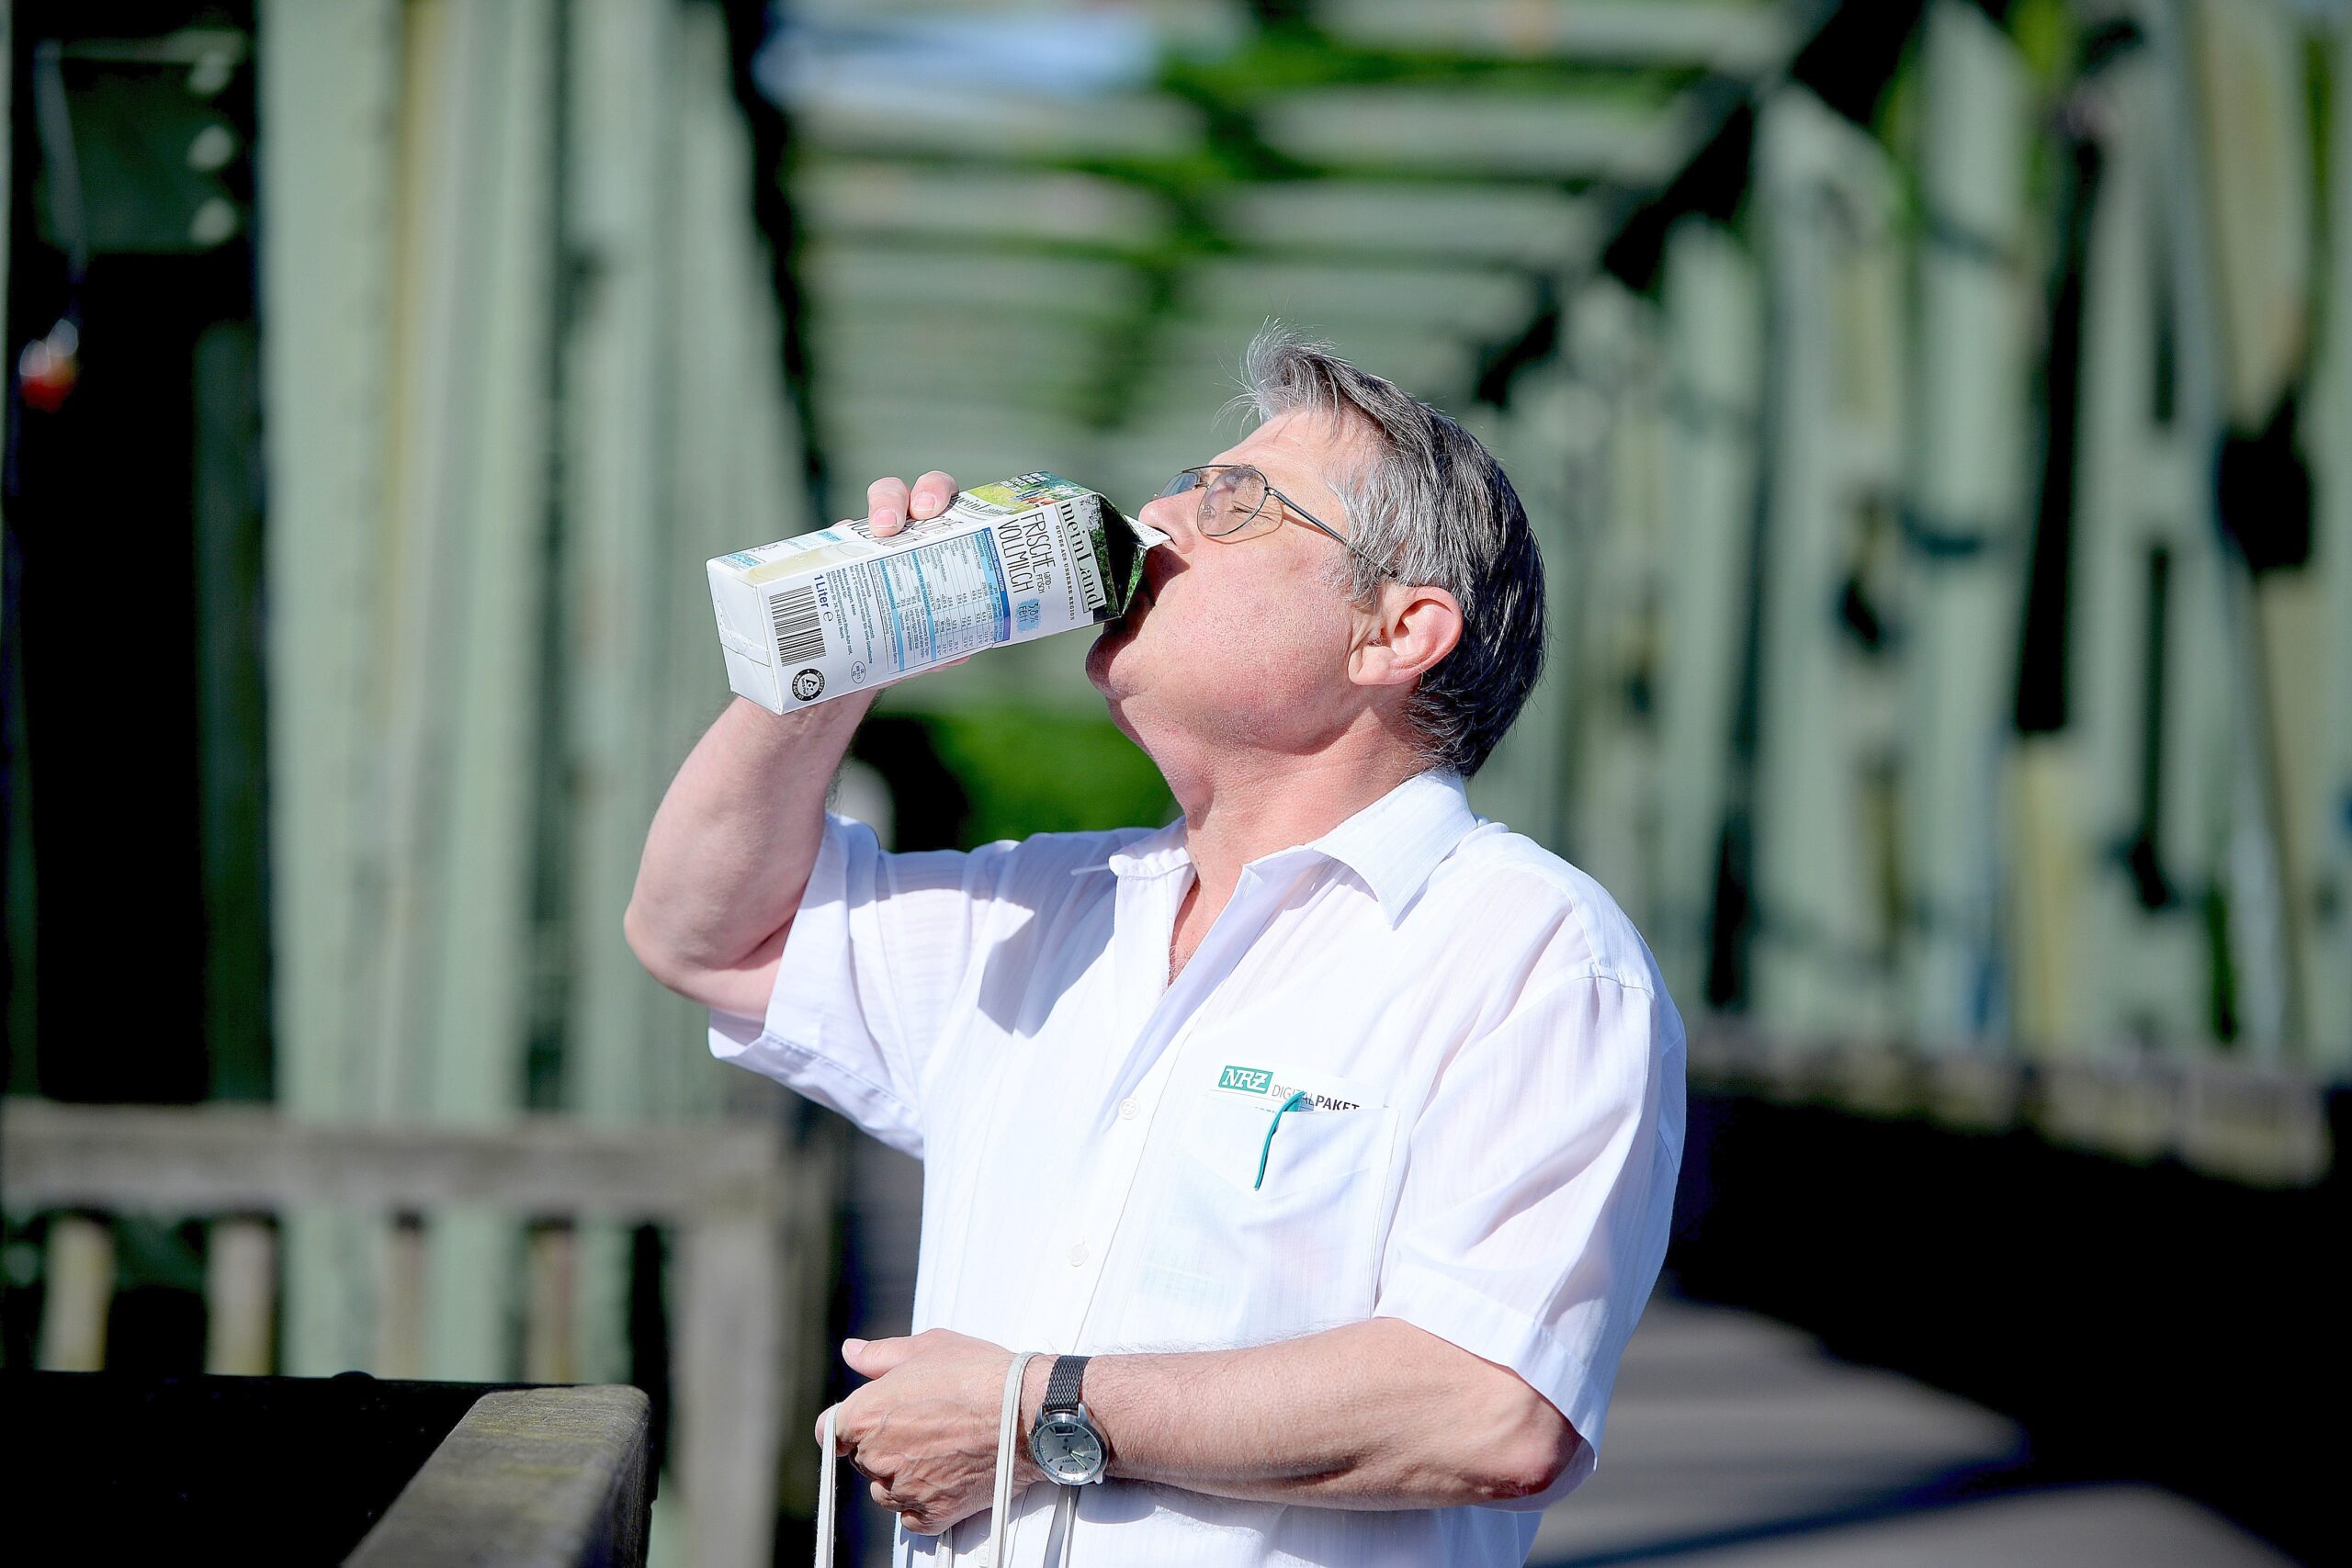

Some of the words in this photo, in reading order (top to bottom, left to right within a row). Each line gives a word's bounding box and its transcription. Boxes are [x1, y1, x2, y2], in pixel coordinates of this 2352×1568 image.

[997, 518, 1035, 593] VOLLMILCH
[1021, 512, 1056, 573] FRISCHE
[1055, 525, 1064, 547] GUTES
[1064, 562, 1073, 594] UNSERER
[815, 581, 831, 608] Liter
[1222, 1068, 1269, 1091] NRZ
